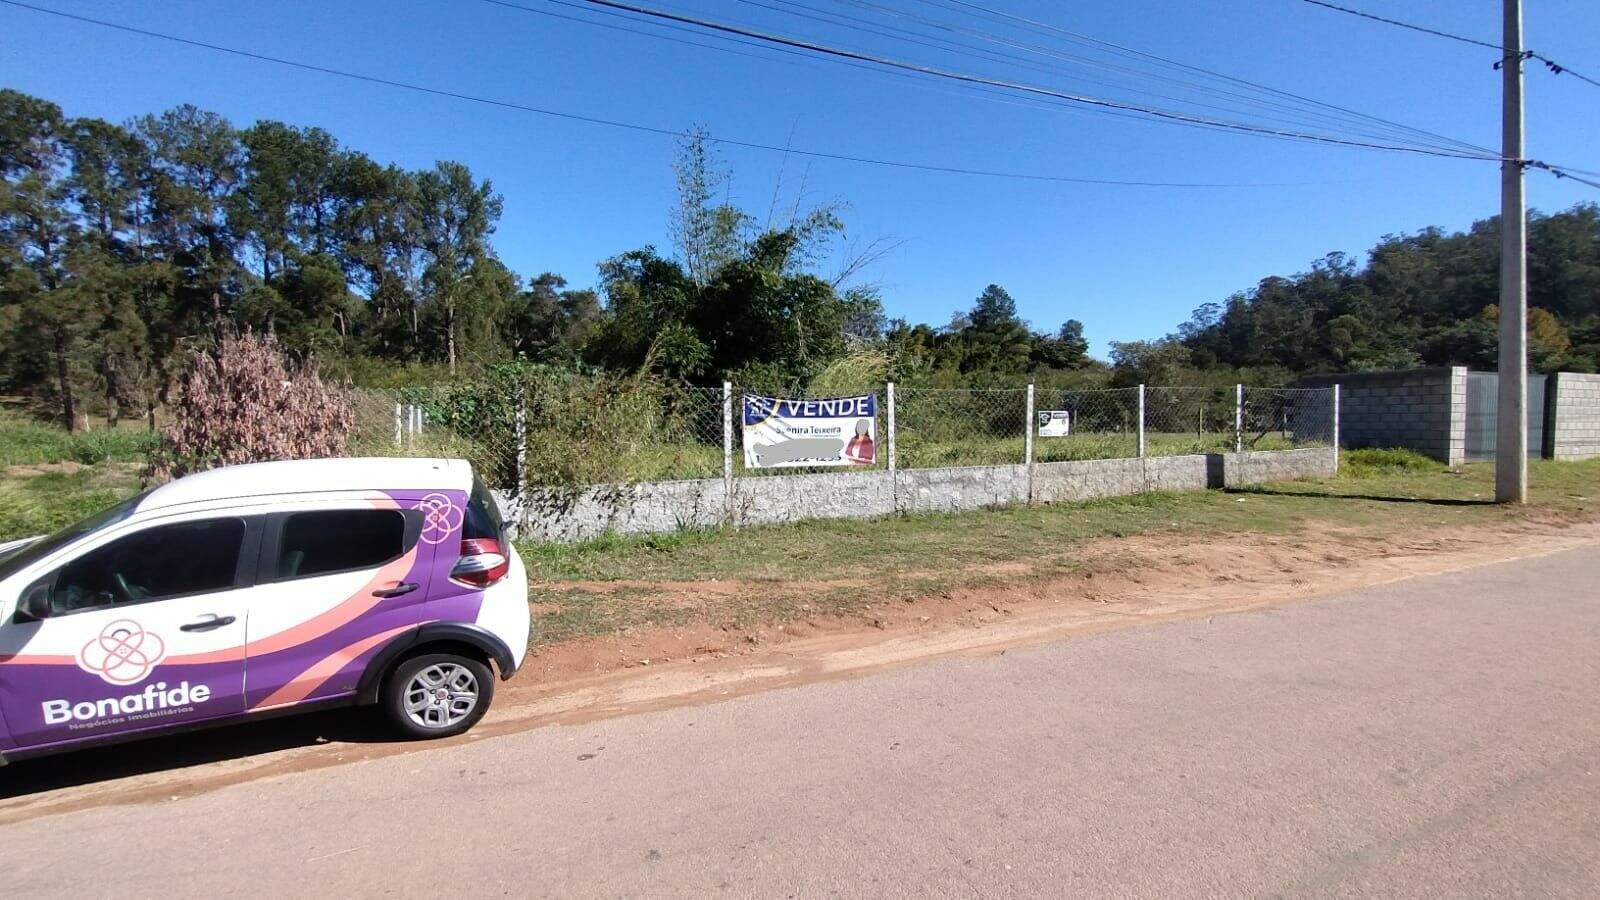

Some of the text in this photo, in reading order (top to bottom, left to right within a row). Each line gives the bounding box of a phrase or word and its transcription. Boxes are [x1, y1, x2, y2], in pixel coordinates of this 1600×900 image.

[786, 397, 869, 416] VENDE
[810, 425, 842, 434] Teixeira
[42, 681, 211, 725] Bonafide
[69, 717, 126, 730] Negócios
